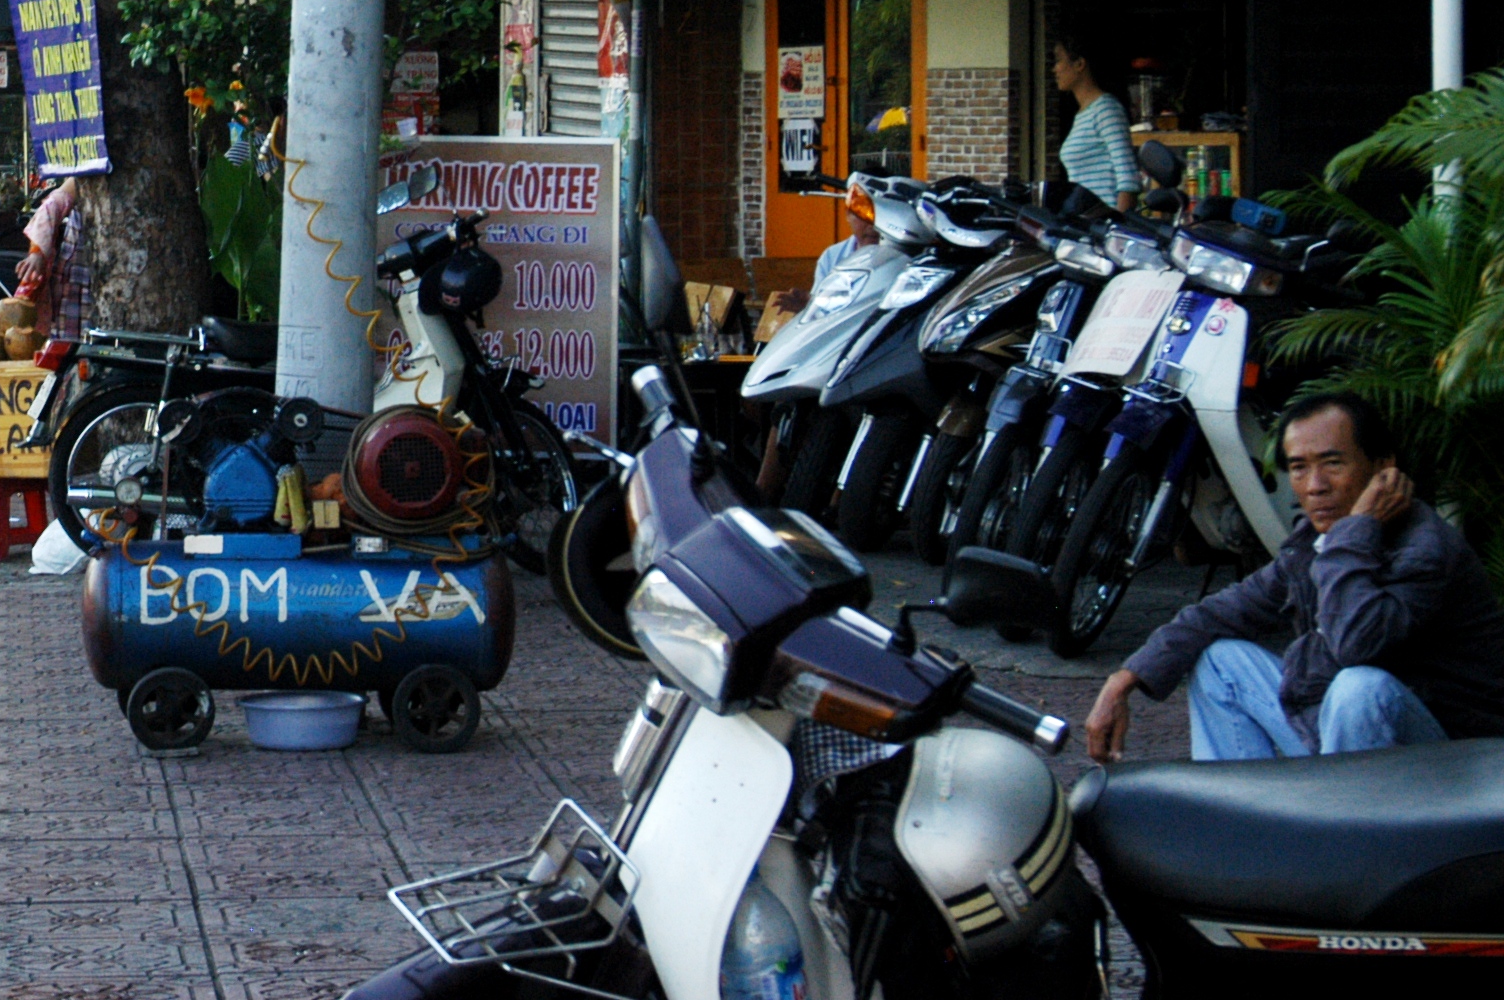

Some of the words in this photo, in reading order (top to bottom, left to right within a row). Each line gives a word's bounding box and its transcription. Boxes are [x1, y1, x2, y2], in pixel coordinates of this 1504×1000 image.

[784, 128, 815, 162] WIFI
[506, 162, 601, 216] COFFEE
[562, 223, 589, 245] ĐI
[514, 260, 597, 312] 10.000
[514, 327, 597, 380] 12.000
[139, 564, 288, 626] BOM
[359, 569, 486, 626] VA
[1317, 934, 1427, 951] HONDA
